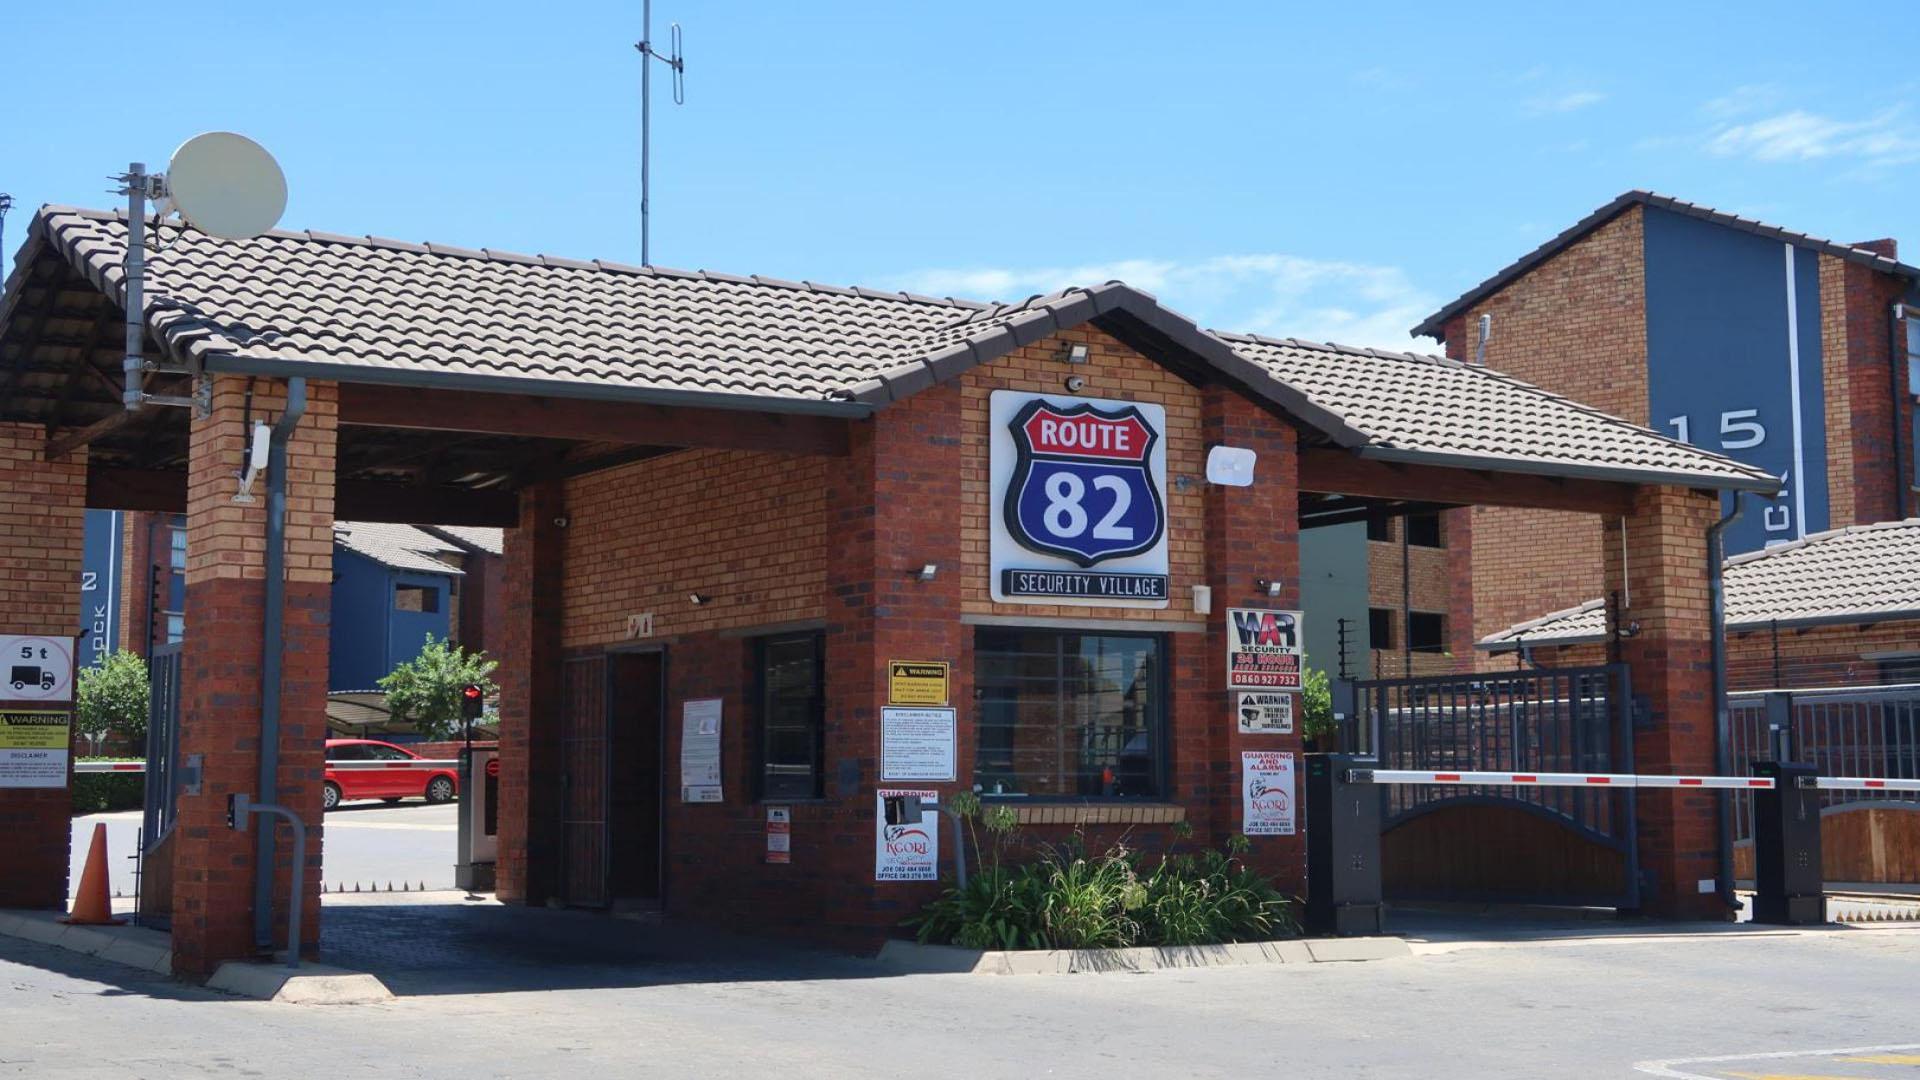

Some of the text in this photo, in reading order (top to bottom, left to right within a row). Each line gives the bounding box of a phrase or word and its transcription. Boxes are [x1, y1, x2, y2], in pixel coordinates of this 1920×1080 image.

[1041, 419, 1130, 451] ROUTE
[1043, 471, 1134, 541] 82
[1020, 574, 1160, 596] SECURITY VILLAGE
[1232, 611, 1296, 648] WAR
[21, 646, 49, 660] 5 t
[1241, 646, 1292, 654] SECURITY
[1235, 674, 1296, 685] 0860 927 732
[1256, 695, 1290, 705] WARNING
[10, 715, 66, 725] WARNING
[1245, 752, 1293, 760] GUARDING
